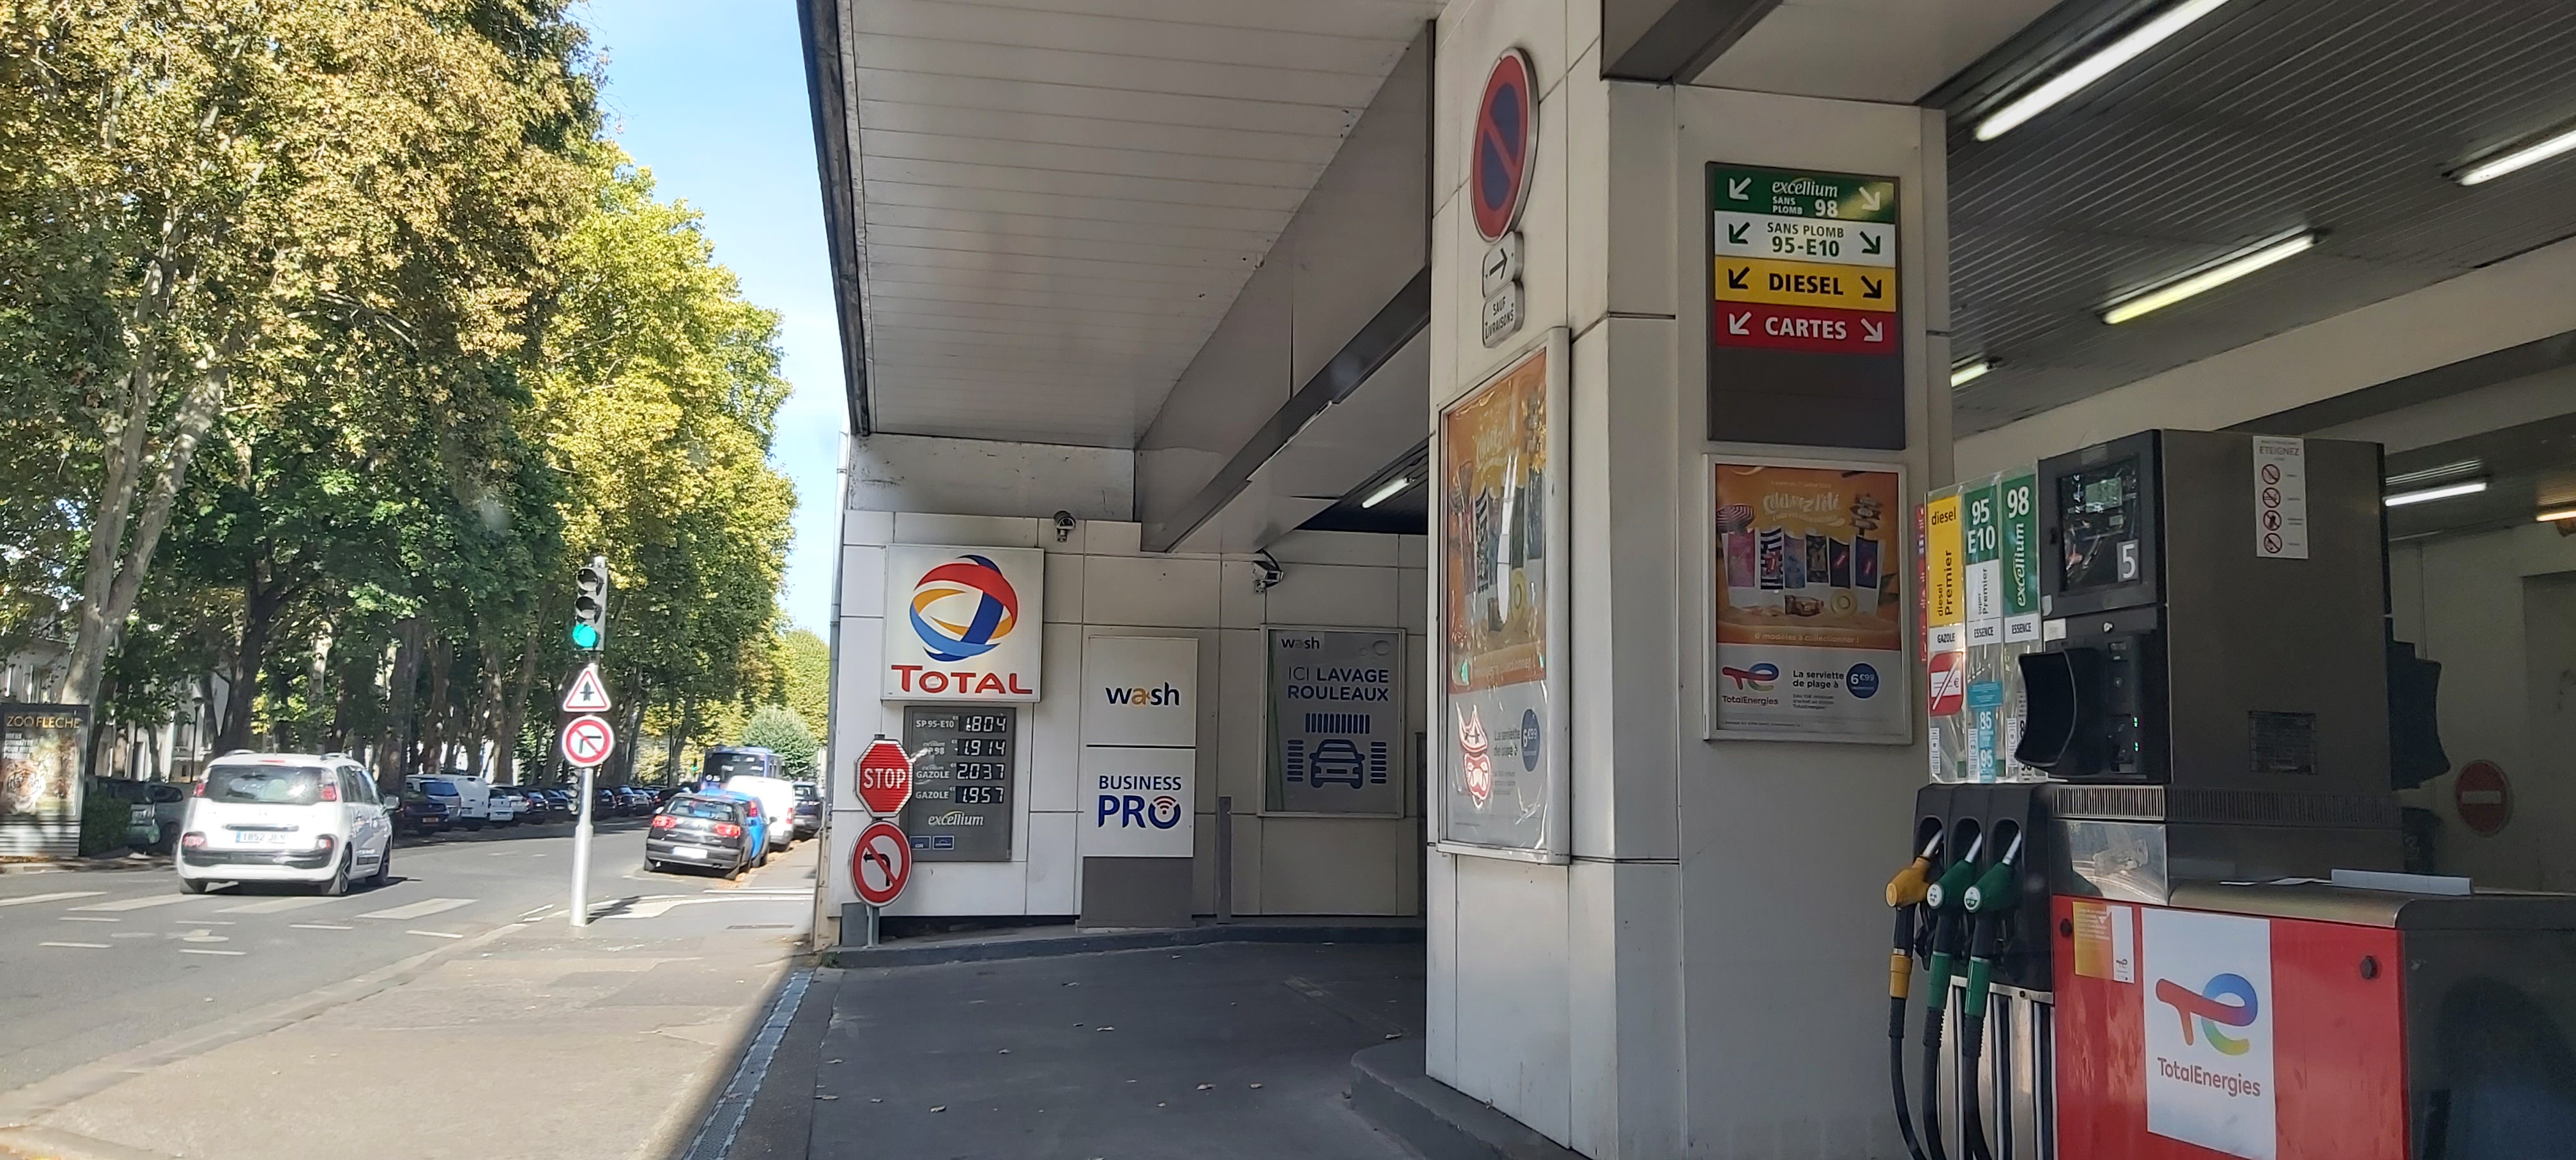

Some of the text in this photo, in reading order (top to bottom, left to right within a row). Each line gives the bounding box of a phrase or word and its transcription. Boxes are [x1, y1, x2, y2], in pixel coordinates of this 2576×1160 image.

[1772, 181, 1838, 198] excellium
[1772, 196, 1796, 205] SANS
[1814, 199, 1838, 218] 98
[1772, 205, 1803, 215] PLOMB
[1767, 222, 1844, 238] SANS PLOMB
[1772, 236, 1840, 257] 95-E10
[1769, 273, 1844, 296] DIESEL
[1492, 296, 1506, 316] SAUF
[1765, 317, 1847, 340] CARTES
[2007, 486, 2030, 519] 98
[1931, 506, 1956, 526] diesel
[1972, 498, 1990, 526] 95
[1967, 525, 1996, 554] E10
[2014, 523, 2025, 607] excellium
[2122, 544, 2136, 579] 5
[1944, 549, 1952, 616] Premier
[1974, 626, 1994, 638] ESSENCE
[2011, 622, 2032, 635] ESSENCE
[1281, 636, 1321, 650] wash
[1936, 632, 1956, 643] GAZOLE
[891, 665, 1033, 694] TOTAL
[1288, 666, 1389, 683] ICI LAVAGE
[1793, 669, 1844, 680] La serviette
[1793, 679, 1839, 689] de plage à
[1105, 682, 1180, 706] wash
[1287, 685, 1389, 702] ROULEAUX
[1722, 695, 1779, 706] TotalEnergies
[6, 716, 34, 727] ZOO
[916, 720, 954, 728] SP 95-E10
[863, 768, 906, 790] STOP
[916, 770, 950, 779] GAZOLE
[957, 763, 1005, 779] 2.037
[1098, 775, 1182, 792] BUSINESS
[916, 791, 949, 799] GAZOLE
[928, 812, 984, 826] excellium
[1098, 794, 1181, 830] PRO
[243, 833, 265, 841] 1852
[2158, 1057, 2261, 1097] TotalEnergies
